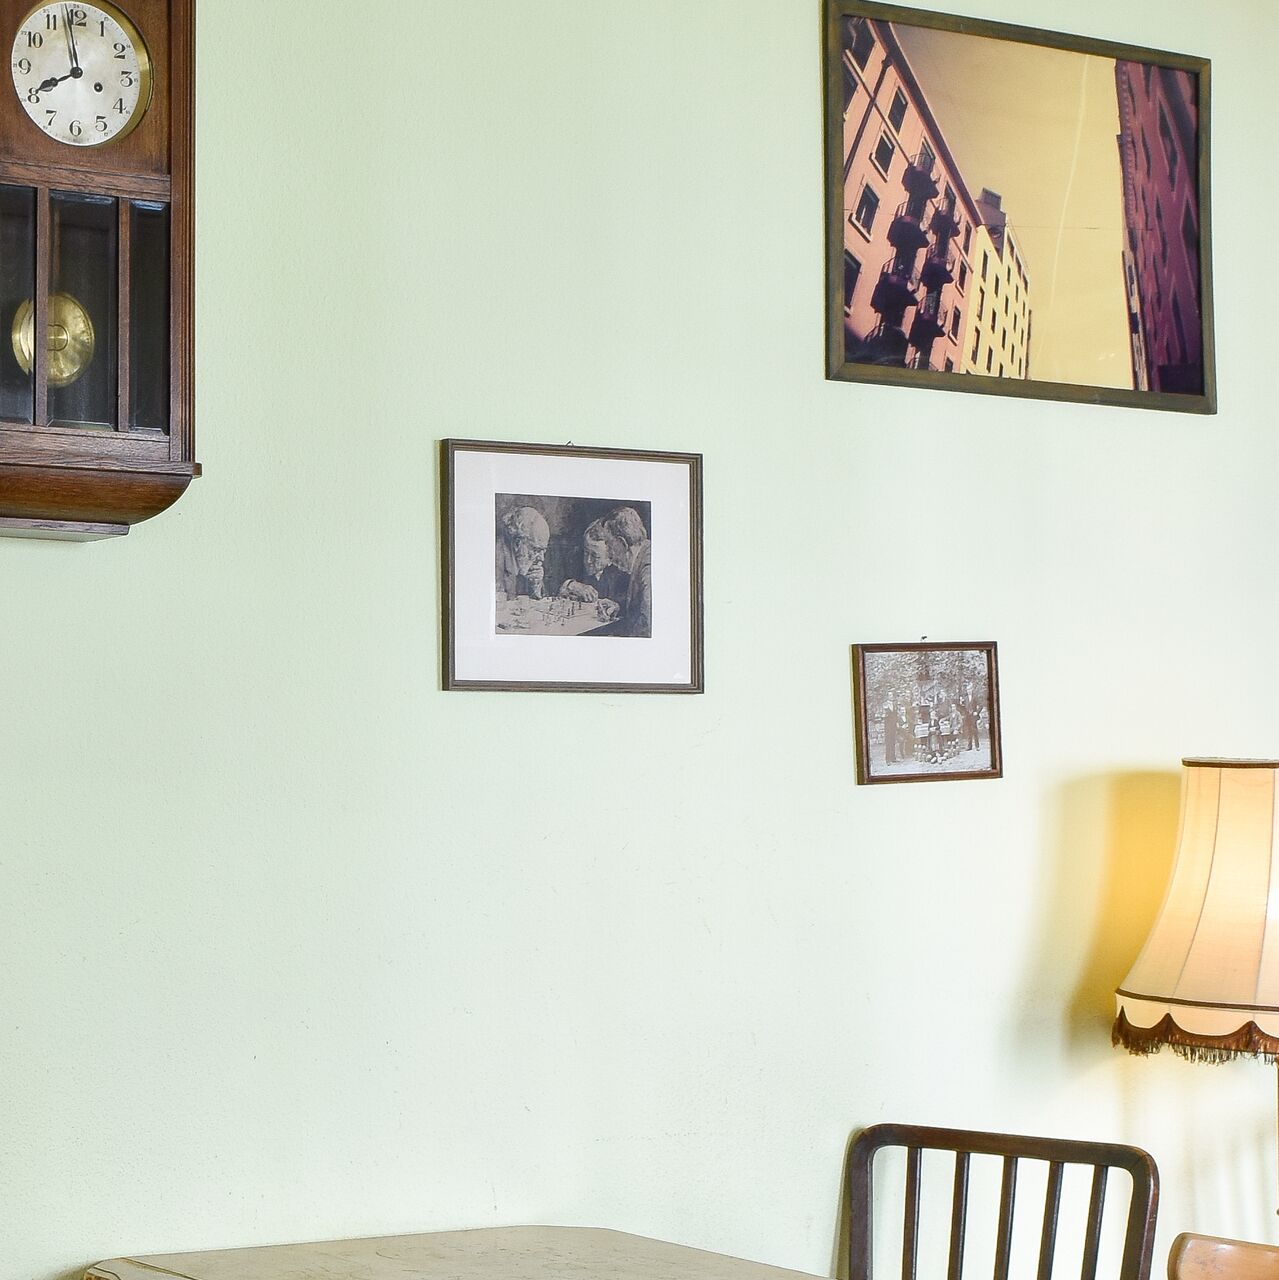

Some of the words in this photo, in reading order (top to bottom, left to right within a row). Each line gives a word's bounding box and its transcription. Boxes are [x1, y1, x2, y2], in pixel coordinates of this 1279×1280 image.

[46, 14, 56, 30] 11
[28, 31, 43, 48] 10
[113, 43, 125, 59] 2
[19, 58, 31, 74] 9
[121, 71, 133, 87] 3
[113, 98, 126, 114] 4
[46, 110, 56, 126] 7
[95, 116, 107, 132] 5
[69, 120, 82, 136] 6
